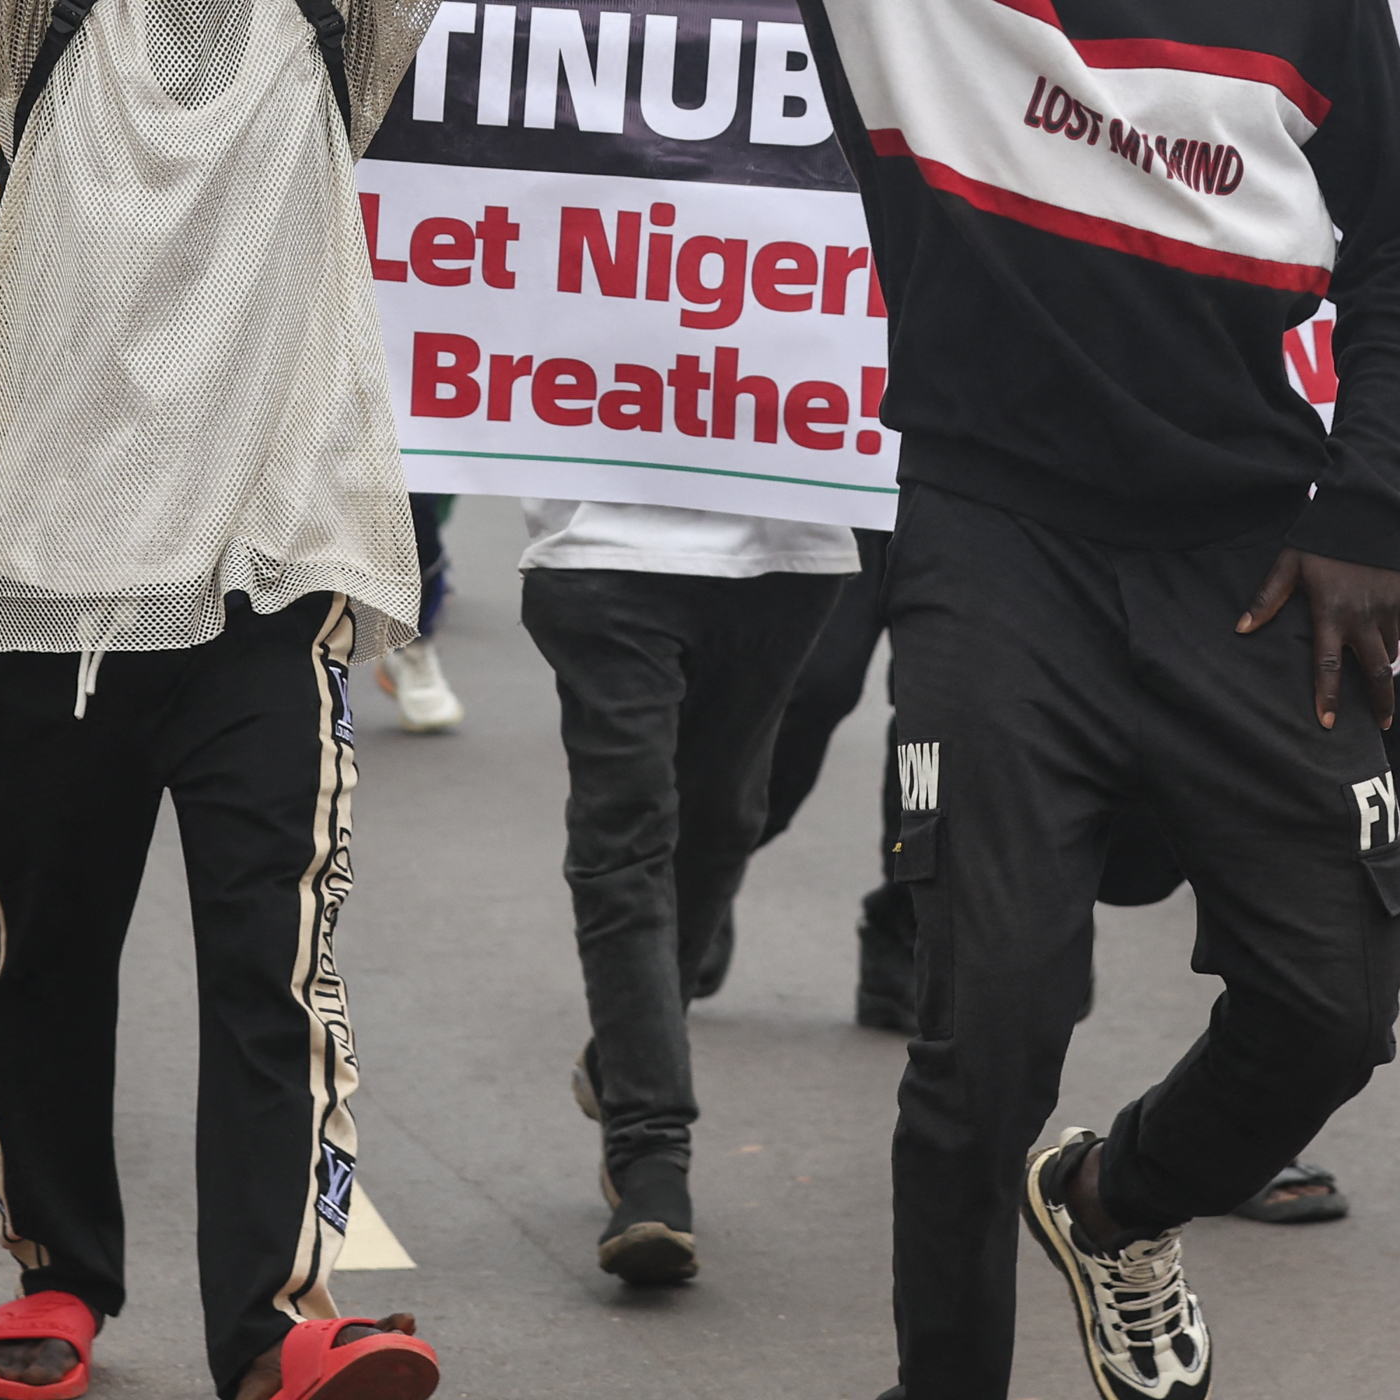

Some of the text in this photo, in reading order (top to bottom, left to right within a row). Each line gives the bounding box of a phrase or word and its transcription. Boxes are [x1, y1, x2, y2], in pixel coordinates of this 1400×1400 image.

[1024, 75, 1103, 146] LOST
[1155, 135, 1244, 196] MIND
[358, 192, 520, 290] Let
[410, 331, 888, 455] Breathe!
